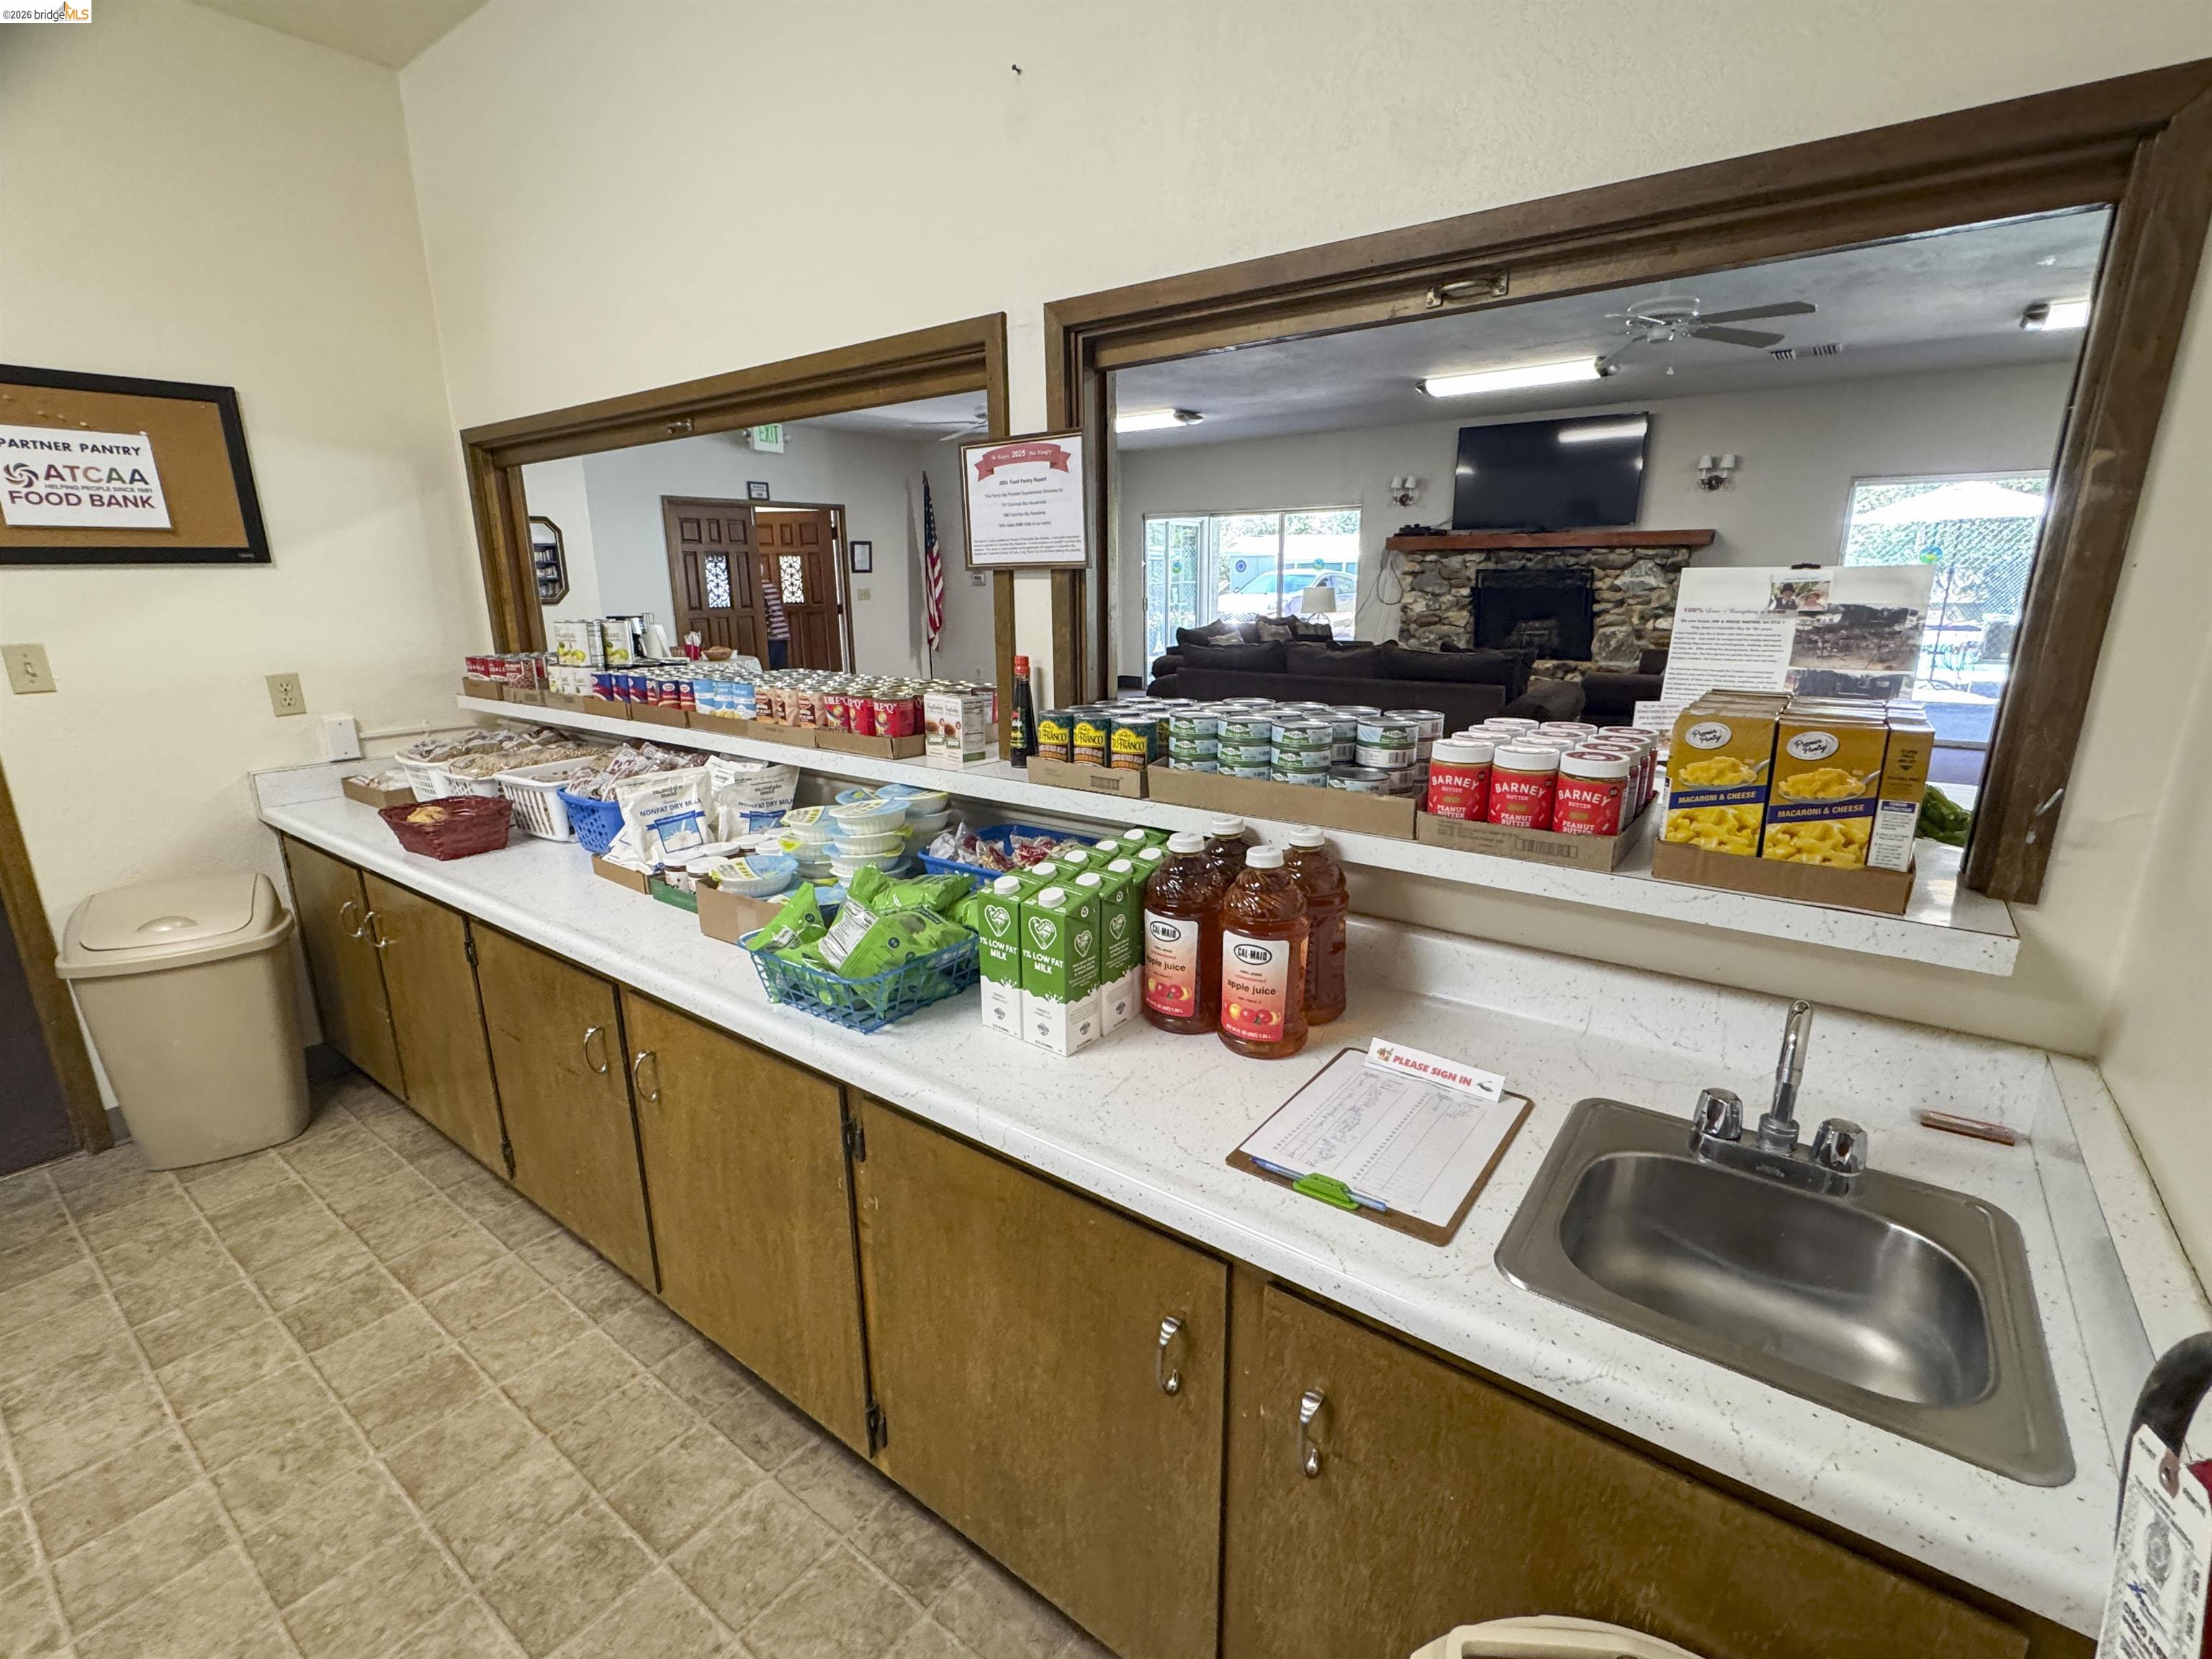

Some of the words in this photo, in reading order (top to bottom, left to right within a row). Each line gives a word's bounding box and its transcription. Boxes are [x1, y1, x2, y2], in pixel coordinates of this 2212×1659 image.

[759, 425, 778, 444] EXIT
[0, 438, 72, 452] PARTNER
[79, 444, 141, 456] PANTRY
[44, 464, 150, 485] ATCAA
[8, 490, 82, 506] FOOD
[89, 493, 156, 508] BANK
[1080, 732, 1104, 745] FRANCO
[1119, 737, 1145, 752] FRANCO
[1431, 775, 1479, 790] BARNEY
[1495, 782, 1546, 799] BARNEY
[1558, 788, 1611, 807] BARNEY
[1678, 794, 1717, 804] MACARONI
[1719, 793, 1725, 801] &
[1727, 791, 1756, 800] CHEESE
[639, 806, 668, 817] NONFAT
[1437, 804, 1467, 813] PEANUT
[1437, 810, 1465, 819] BUTTER
[1777, 807, 1821, 818] MACARONI
[1832, 804, 1865, 814] CHEESE
[1501, 812, 1533, 822] PEANUT
[1501, 819, 1532, 828] BUTTER
[1562, 820, 1596, 830] PEANUT
[980, 936, 989, 945] 1%
[989, 939, 1005, 950] LOW
[1005, 944, 1017, 955] FAT
[990, 948, 1007, 961] MILK
[1022, 949, 1032, 958] 1%
[1033, 952, 1051, 963] LOW
[1051, 957, 1064, 968] FAT
[1237, 947, 1267, 961] CAL-MAID
[1034, 961, 1052, 974] MILK
[1164, 960, 1186, 971] juice
[1228, 979, 1249, 991] apple
[1252, 984, 1277, 995] juice
[1393, 1056, 1429, 1072] PLEASE
[1431, 1067, 1457, 1082] SIGN
[1459, 1075, 1473, 1087] IN
